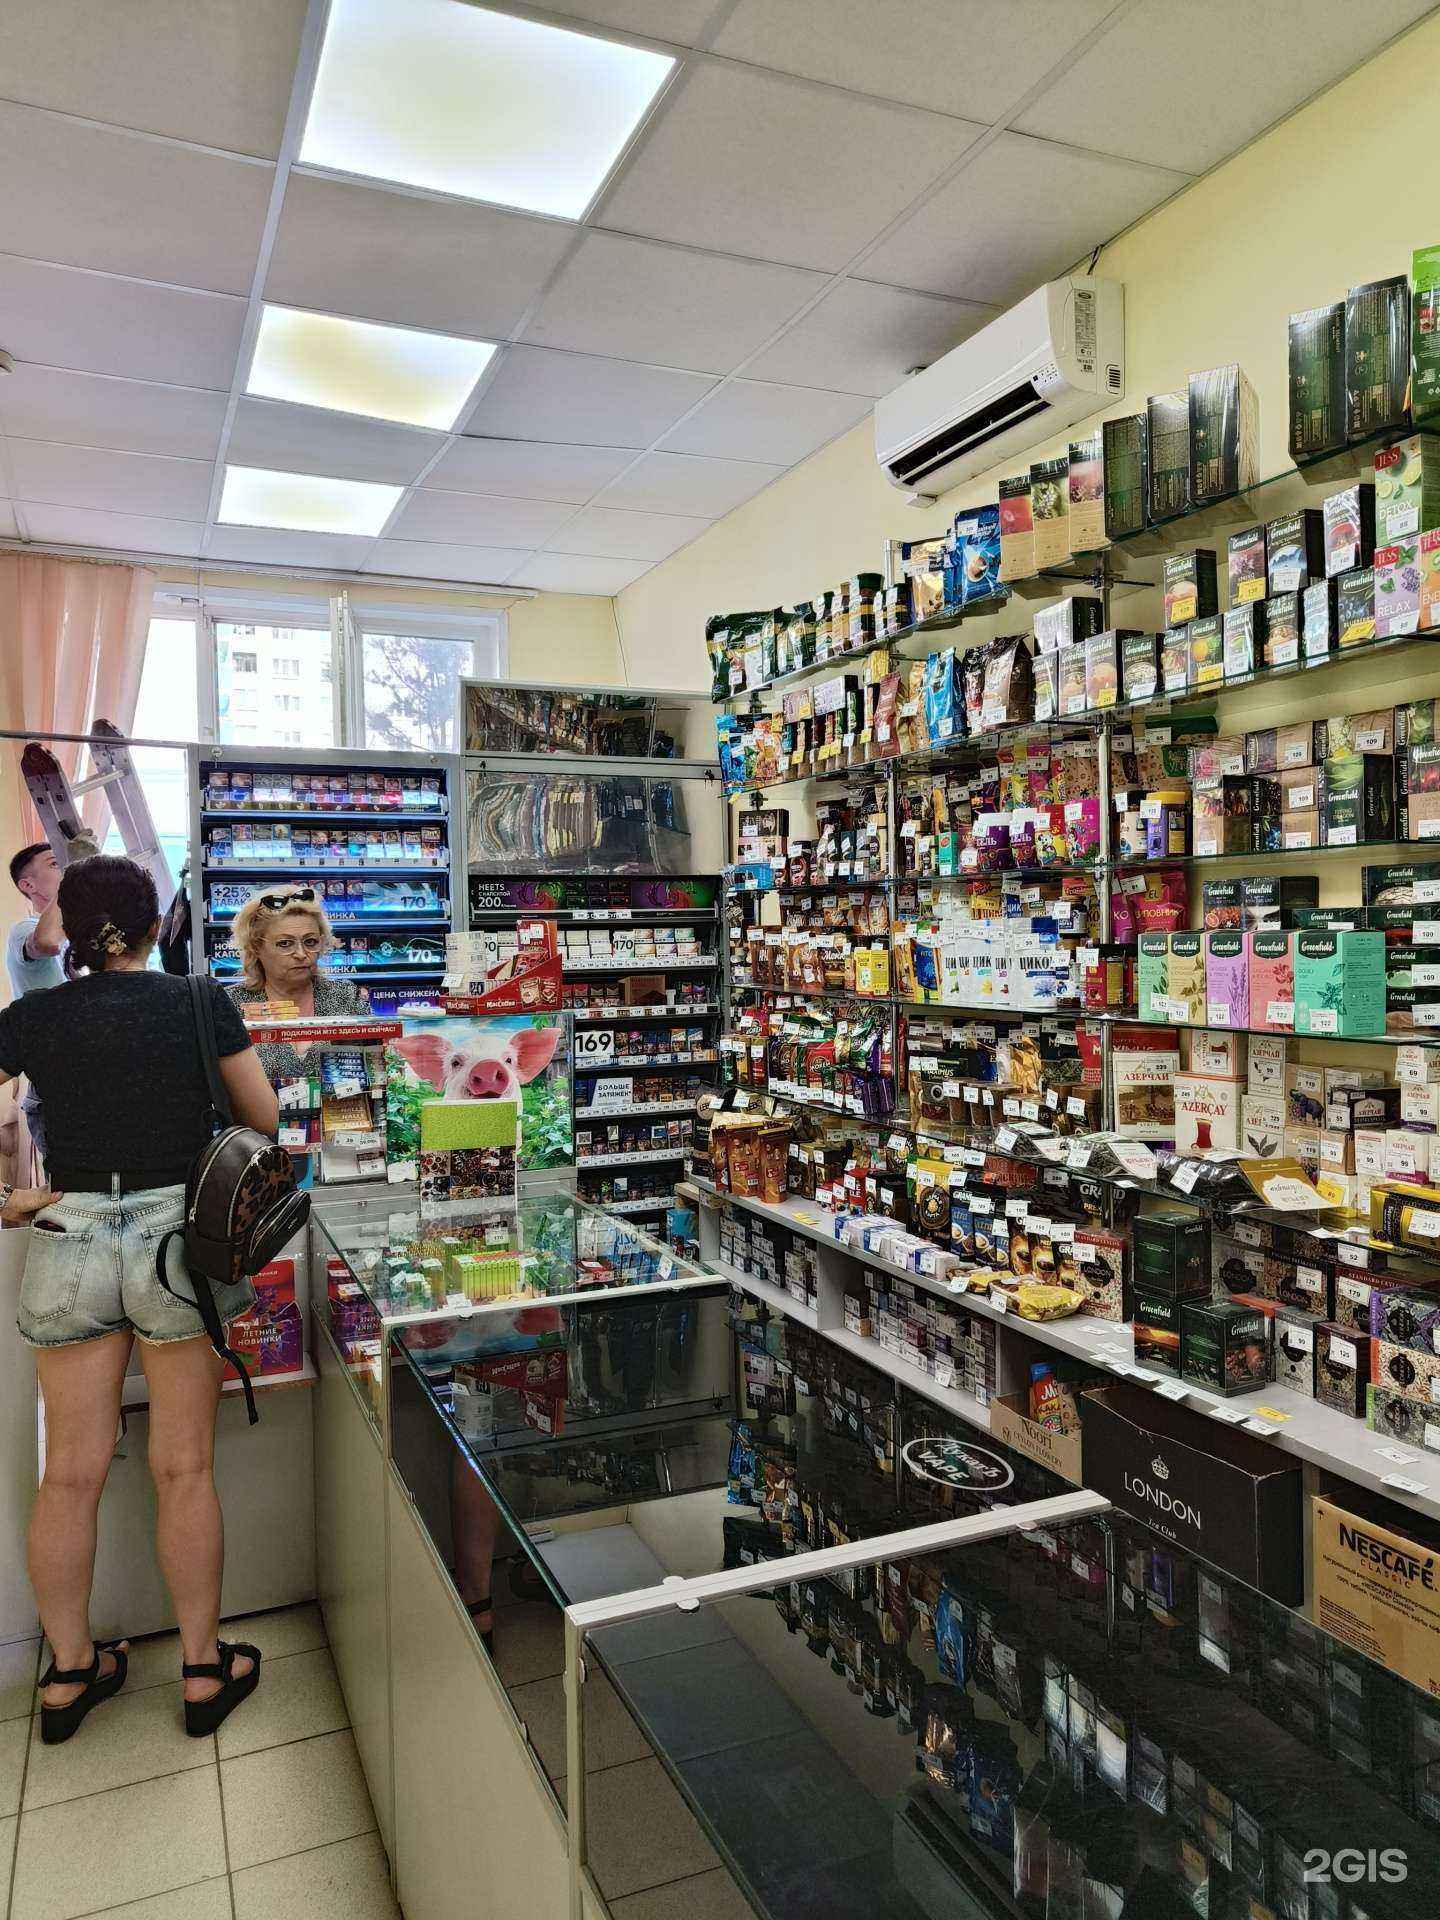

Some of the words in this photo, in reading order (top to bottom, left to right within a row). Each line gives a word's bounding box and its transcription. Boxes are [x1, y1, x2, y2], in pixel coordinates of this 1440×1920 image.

[1379, 500, 1413, 520] DETOX
[1271, 520, 1301, 538] Greenfield
[1232, 533, 1259, 549] Greenfield
[1377, 550, 1398, 565] TESS
[1166, 559, 1193, 576] Greenfield
[1342, 573, 1374, 591] Greenfield
[1377, 599, 1411, 618] RELAX
[1125, 641, 1152, 656] Greenfield
[1328, 789, 1360, 802] Greenfield
[1387, 867, 1415, 879] Greenfield
[214, 886, 251, 898] +25%
[478, 883, 505, 891] HEETS
[478, 896, 502, 908] 200
[1310, 911, 1334, 921] Greenfield
[1386, 910, 1413, 920] Greenfield
[614, 939, 634, 950] 170
[1301, 940, 1334, 952] Greenfield
[1390, 951, 1416, 961] Greenfield
[373, 991, 397, 999] ЦЕНА
[398, 989, 441, 998] СНИЖЕНА
[1390, 992, 1416, 1002] Greenfield
[281, 1029, 321, 1037] ПОДКЛЮЧИ
[338, 1027, 361, 1035] ЗДЕСЬ
[367, 1026, 396, 1034] СЕЙЧАС!
[575, 1032, 612, 1053] 169
[597, 1083, 631, 1091] БОЛЬШЕ
[1181, 1101, 1228, 1117] AZERÇAY
[1139, 1301, 1172, 1319] Greenfield
[242, 1327, 278, 1338] ЛЕТНИЕ
[1230, 1319, 1260, 1337] Greenfield
[238, 1335, 282, 1347] НОВИНКИ
[917, 1450, 970, 1481] VAPE
[1124, 1471, 1201, 1530] LONDON
[1148, 1518, 1160, 1530] Tea
[1161, 1525, 1177, 1539] Club
[1360, 1558, 1412, 1589] CLASSIC
